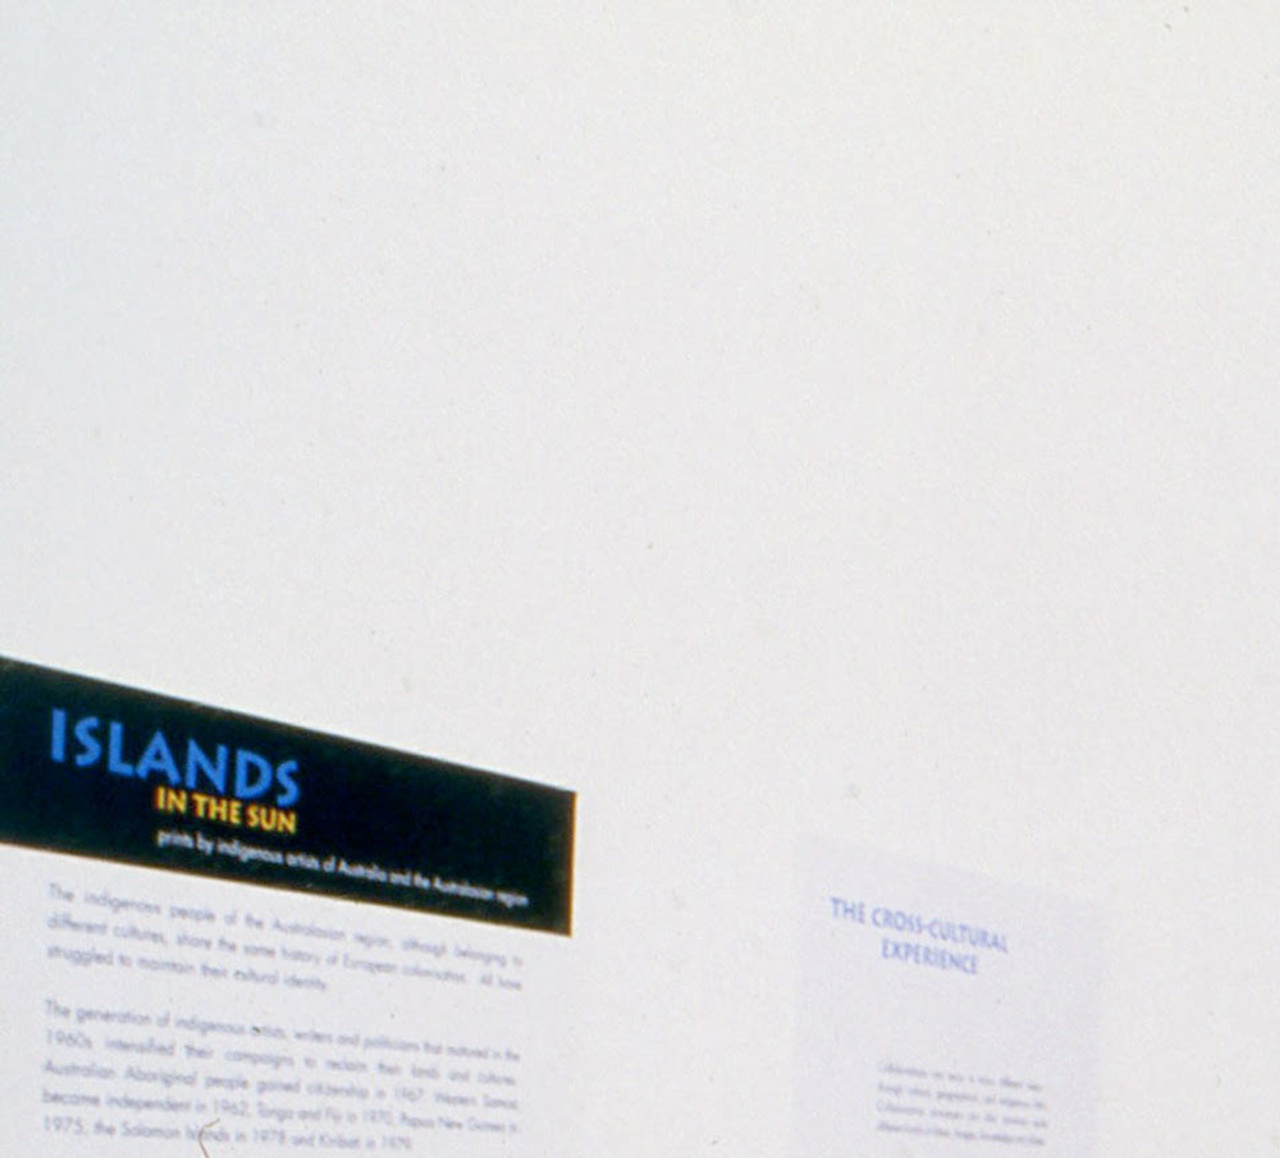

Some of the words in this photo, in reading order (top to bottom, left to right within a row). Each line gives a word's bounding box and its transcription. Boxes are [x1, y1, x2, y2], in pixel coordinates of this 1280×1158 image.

[51, 708, 301, 806] ISLANDS
[156, 787, 187, 814] IN
[192, 793, 241, 825] THE
[246, 803, 296, 834] SUN
[157, 829, 193, 849] prints
[196, 831, 214, 855] by
[217, 838, 284, 865] indigenous
[323, 855, 336, 873] of
[338, 860, 387, 883] Australia
[830, 897, 866, 925] THE
[871, 906, 1009, 954] CROSS-CULTURAL
[881, 938, 978, 975] EXPERIENCE
